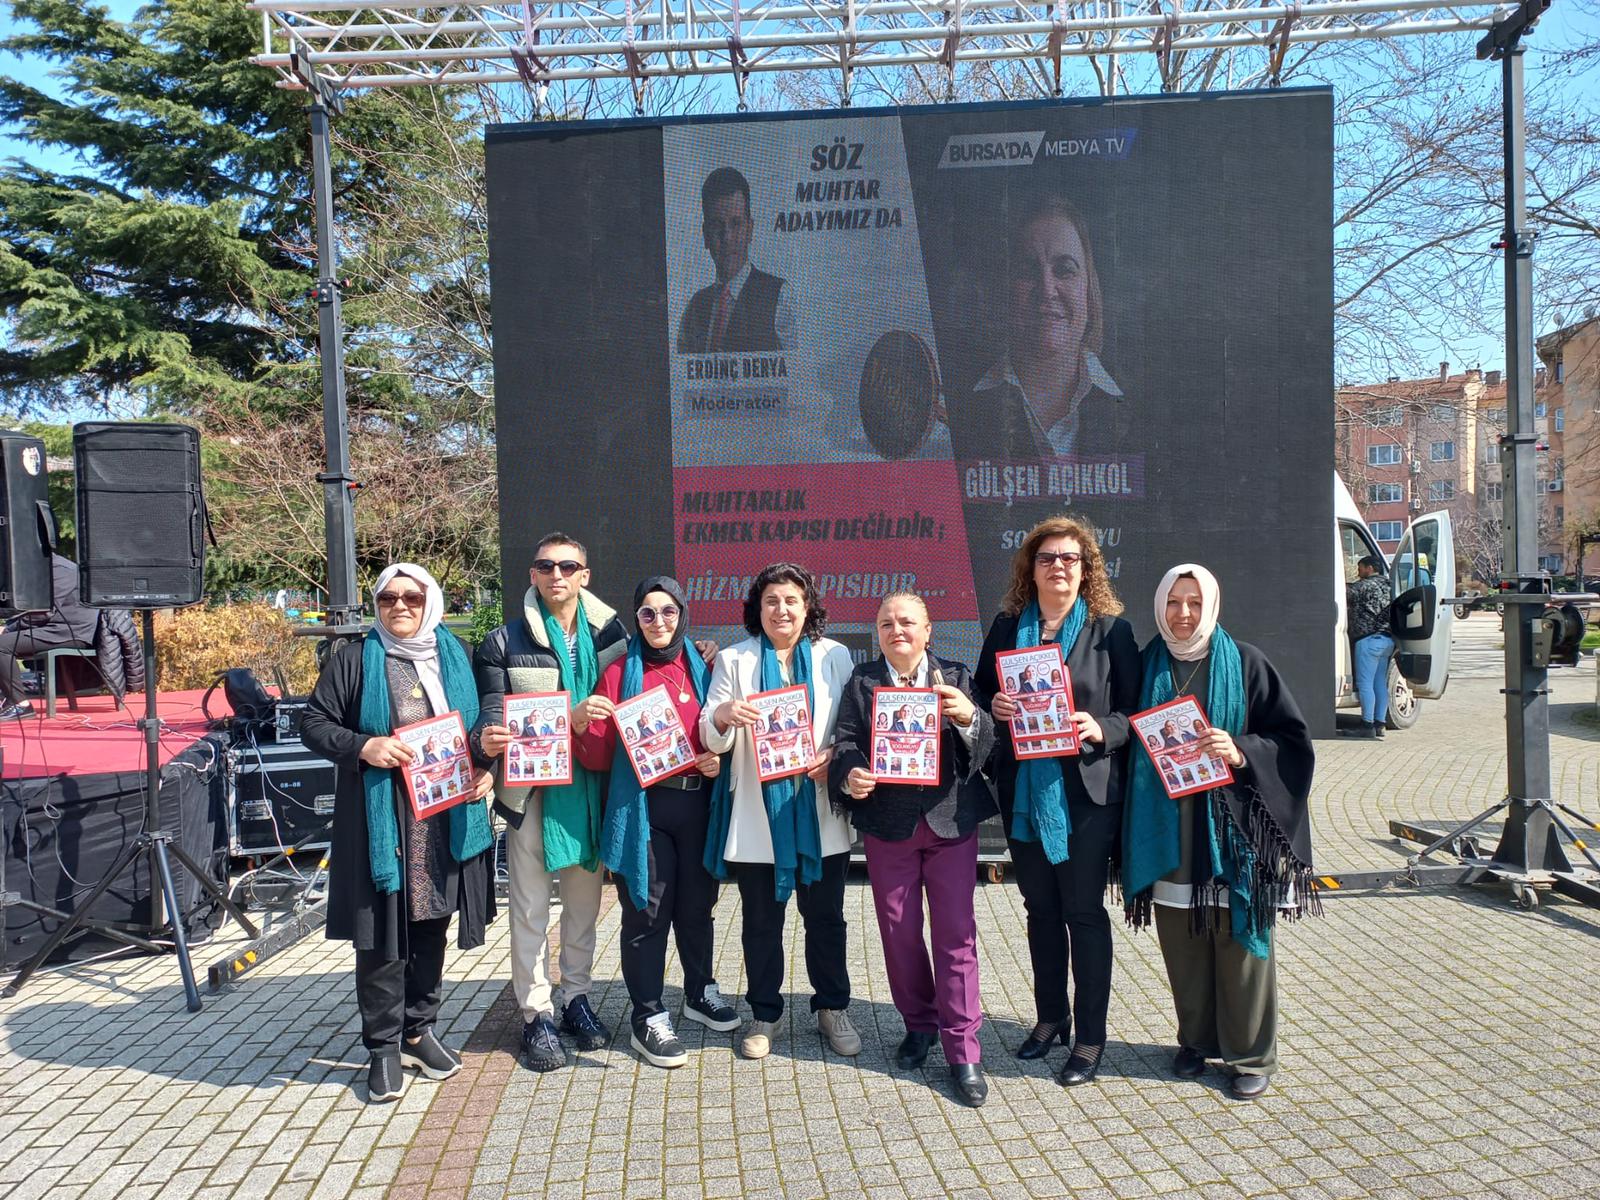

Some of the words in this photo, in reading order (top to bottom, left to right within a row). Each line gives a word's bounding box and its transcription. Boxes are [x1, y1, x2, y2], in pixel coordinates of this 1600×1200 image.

[810, 136, 865, 171] SÖZ
[949, 141, 1033, 162] BURSA'DA
[1045, 138, 1100, 157] MEDYA
[1105, 137, 1125, 154] TV
[795, 179, 880, 202] MUHTAR
[773, 209, 873, 232] ADAYIMIZ
[875, 207, 902, 229] DA
[742, 357, 787, 378] DERYA
[692, 394, 781, 411] Moderatör
[966, 460, 1040, 506] GÜLŞEN
[1048, 462, 1132, 505] AÇIKKOL
[682, 488, 806, 513] MUHTARLIK
[683, 519, 754, 544] EKMEK
[758, 518, 831, 543] KAPISI
[686, 569, 751, 601] HİZM
